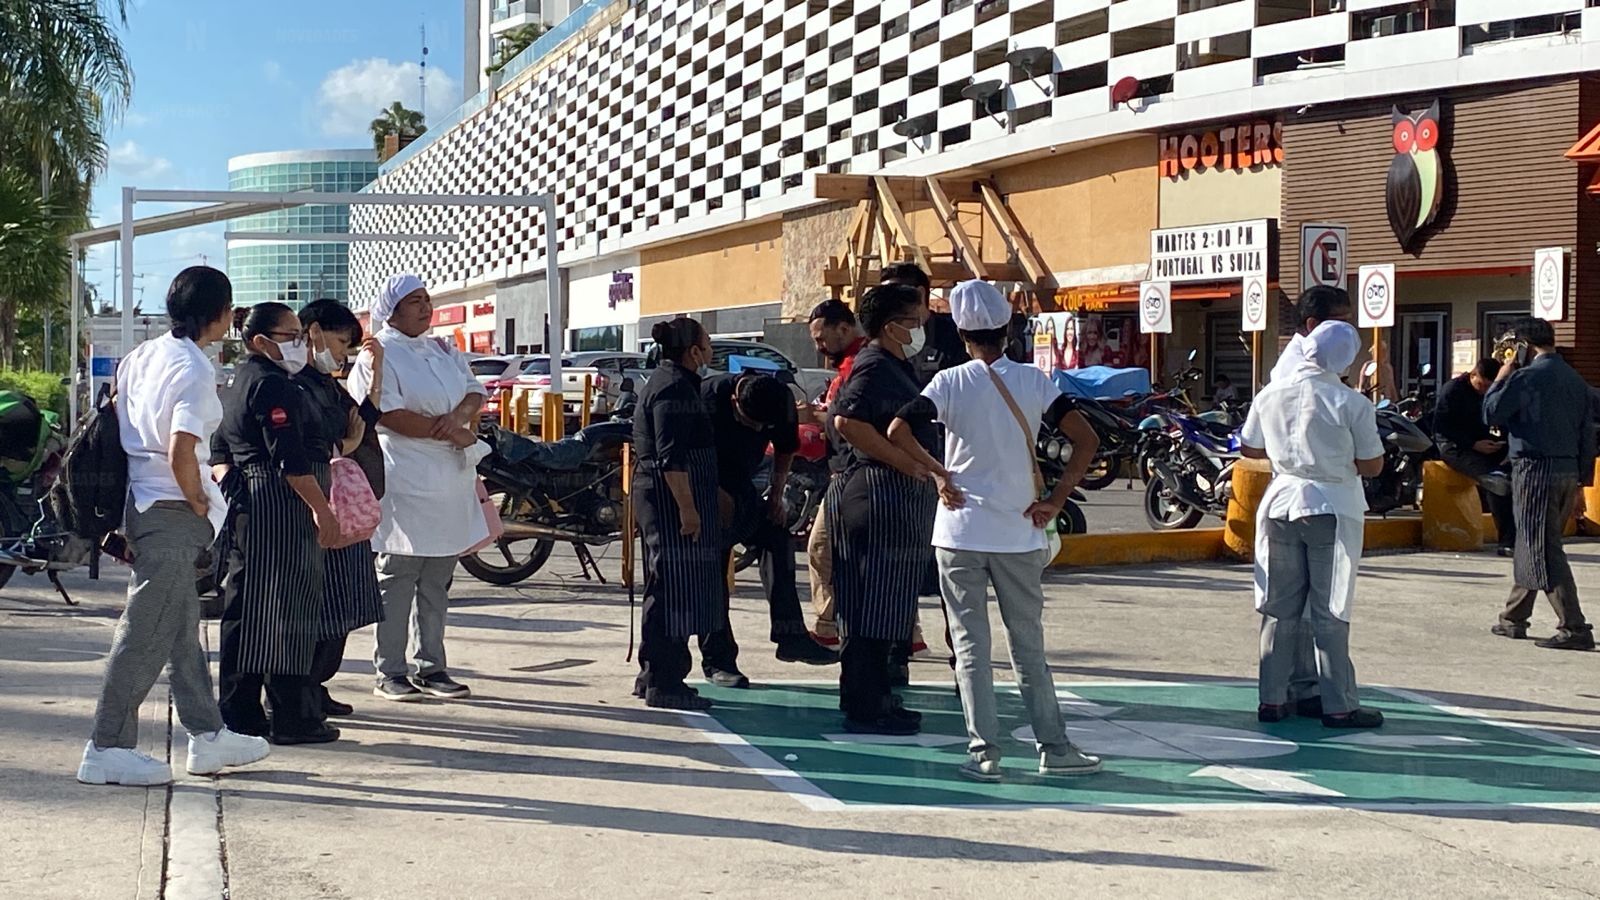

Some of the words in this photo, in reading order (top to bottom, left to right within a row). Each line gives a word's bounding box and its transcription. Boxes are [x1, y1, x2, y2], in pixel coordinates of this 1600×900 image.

[1157, 232, 1196, 253] MARTES
[1203, 228, 1231, 249] 2:00
[1238, 226, 1253, 246] PM
[1157, 256, 1204, 278] PORTUGAL
[1211, 254, 1224, 273] VS
[1230, 251, 1261, 273] SUIZA
